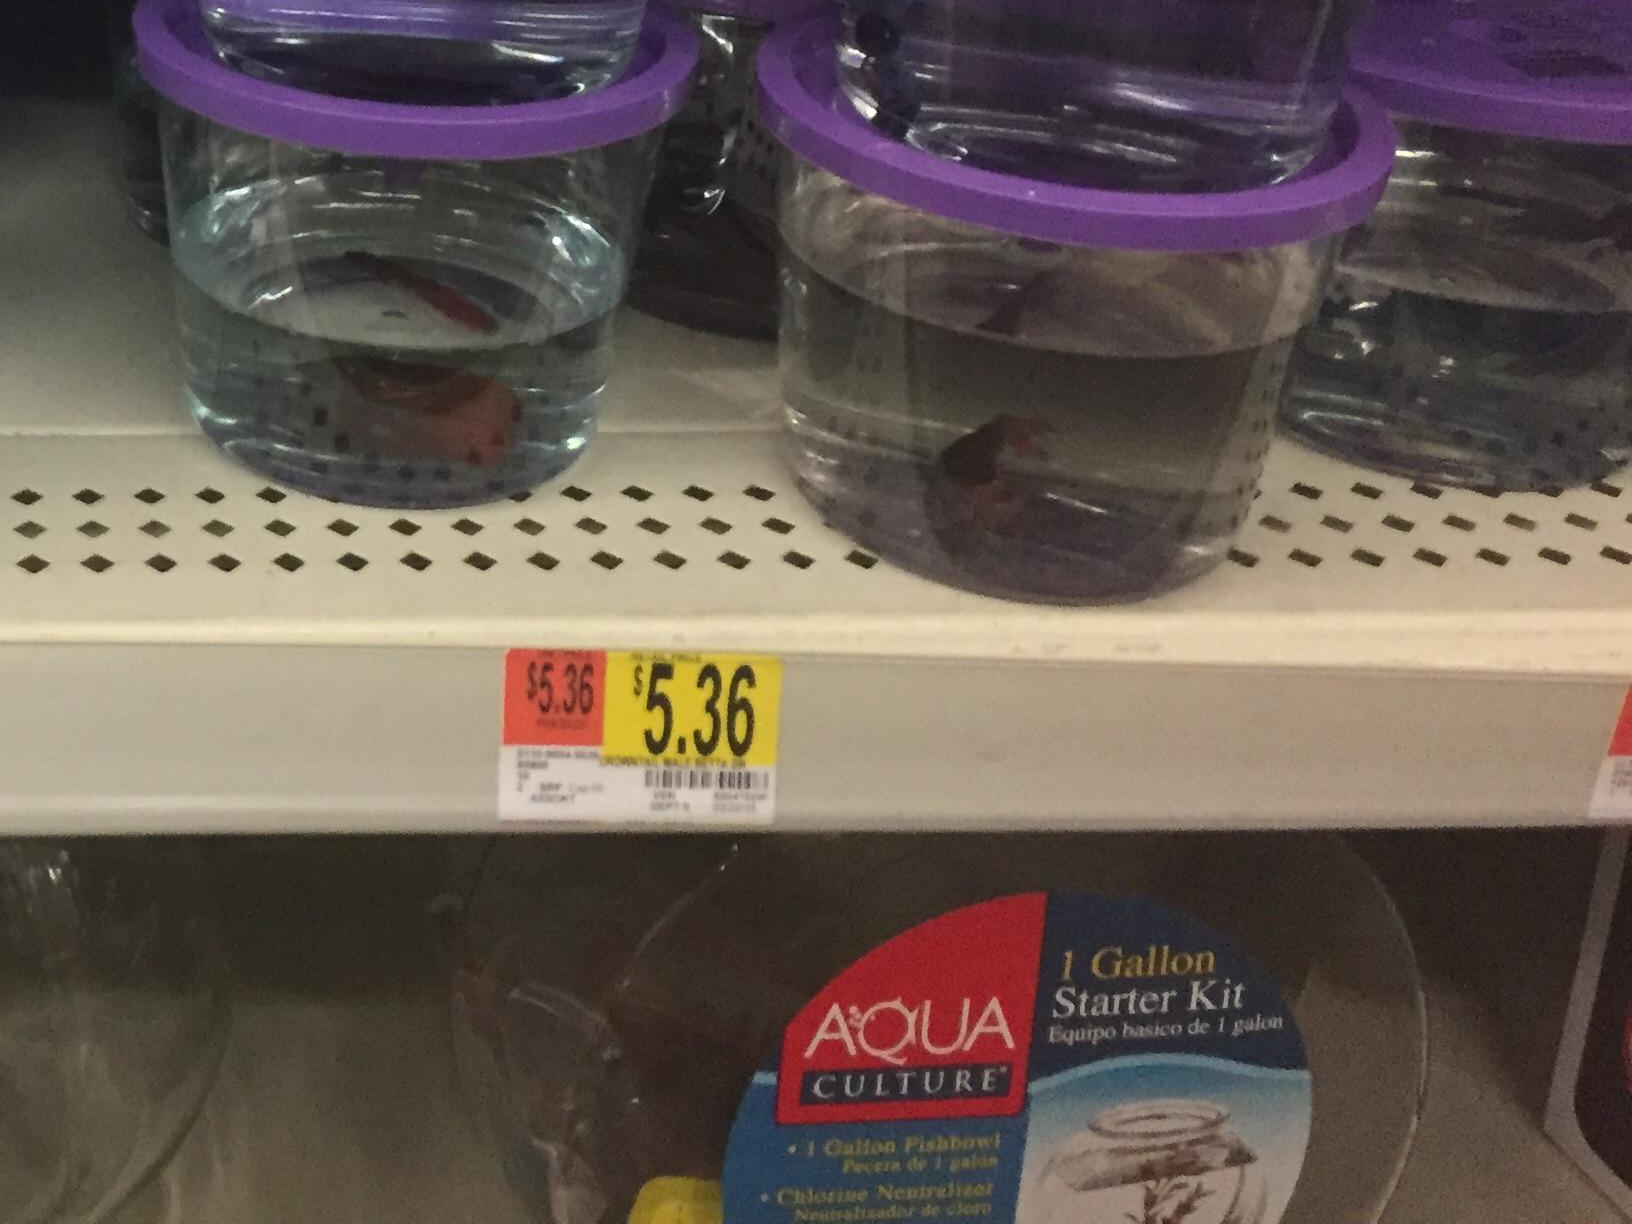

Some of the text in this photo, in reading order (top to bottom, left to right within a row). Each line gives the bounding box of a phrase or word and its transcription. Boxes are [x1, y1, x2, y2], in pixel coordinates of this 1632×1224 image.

[527, 661, 595, 715] $5.36
[633, 662, 757, 757] $5.36
[1063, 943, 1216, 980] 1 Gallon
[1051, 977, 1248, 1019] Starter Kit
[1047, 1024, 1117, 1047] Equipo
[1187, 1017, 1211, 1036] de
[811, 1069, 1001, 1099] CULTURE
